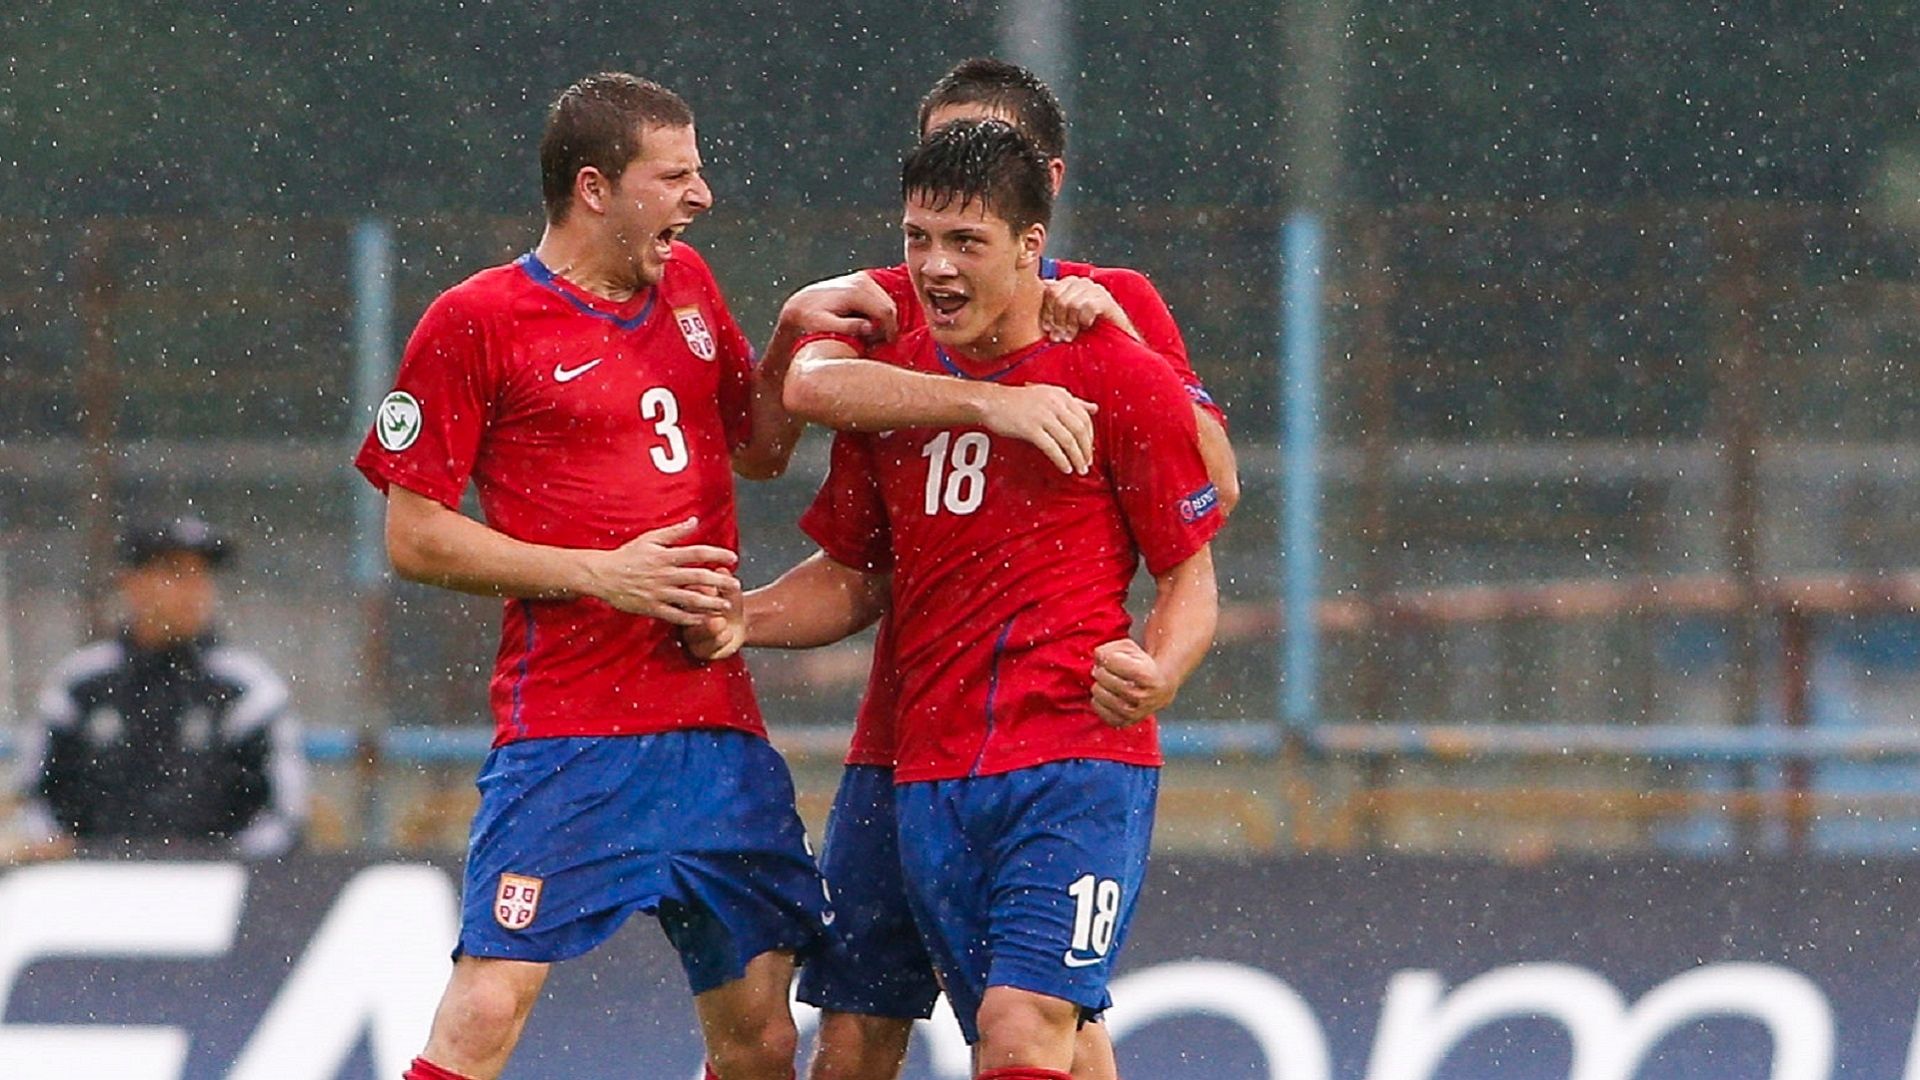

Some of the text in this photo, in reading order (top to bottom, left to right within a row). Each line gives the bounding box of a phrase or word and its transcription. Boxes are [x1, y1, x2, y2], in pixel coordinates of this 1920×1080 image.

[640, 386, 689, 474] 3
[921, 431, 991, 516] 18
[1068, 873, 1120, 957] 18
